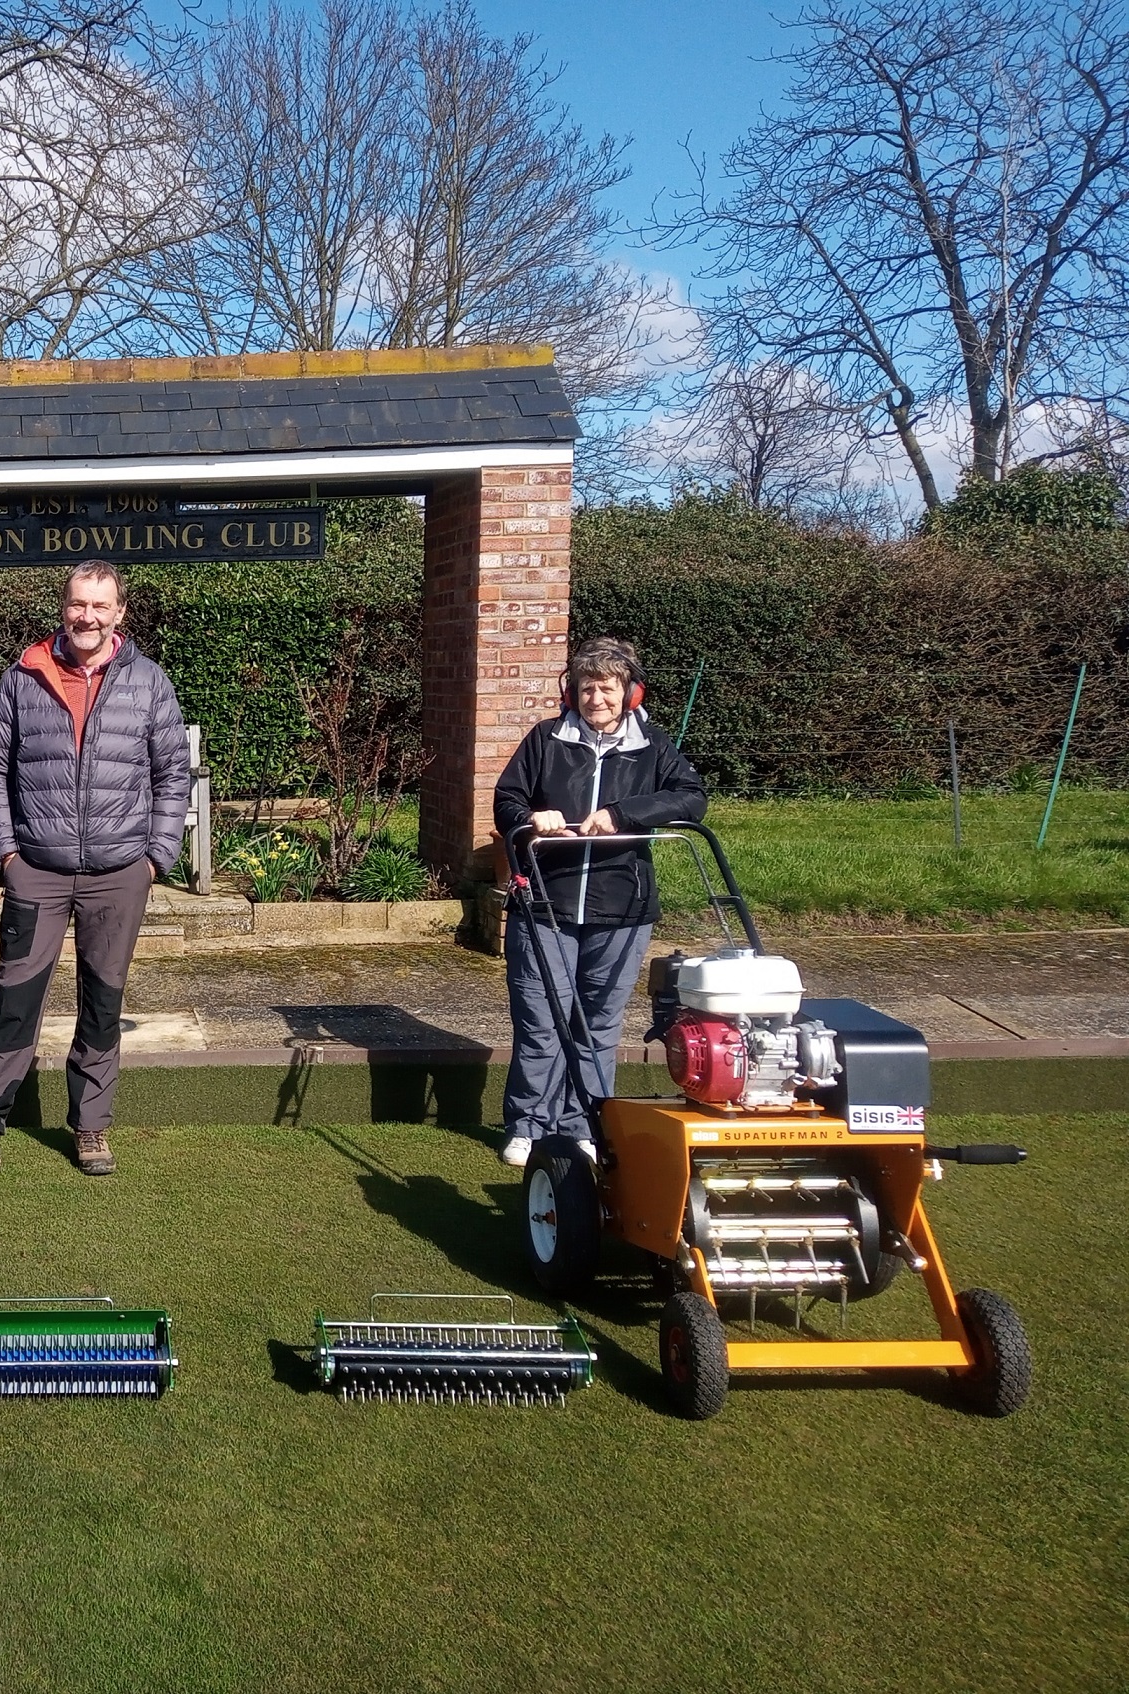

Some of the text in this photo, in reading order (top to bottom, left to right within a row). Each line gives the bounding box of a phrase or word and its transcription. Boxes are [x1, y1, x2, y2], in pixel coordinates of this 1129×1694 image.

[30, 493, 159, 515] EST. 1908
[42, 523, 205, 552] BOWLING
[221, 521, 312, 548] CLUB
[724, 1131, 828, 1141] SUPATURFMAN
[836, 1131, 843, 1139] 2
